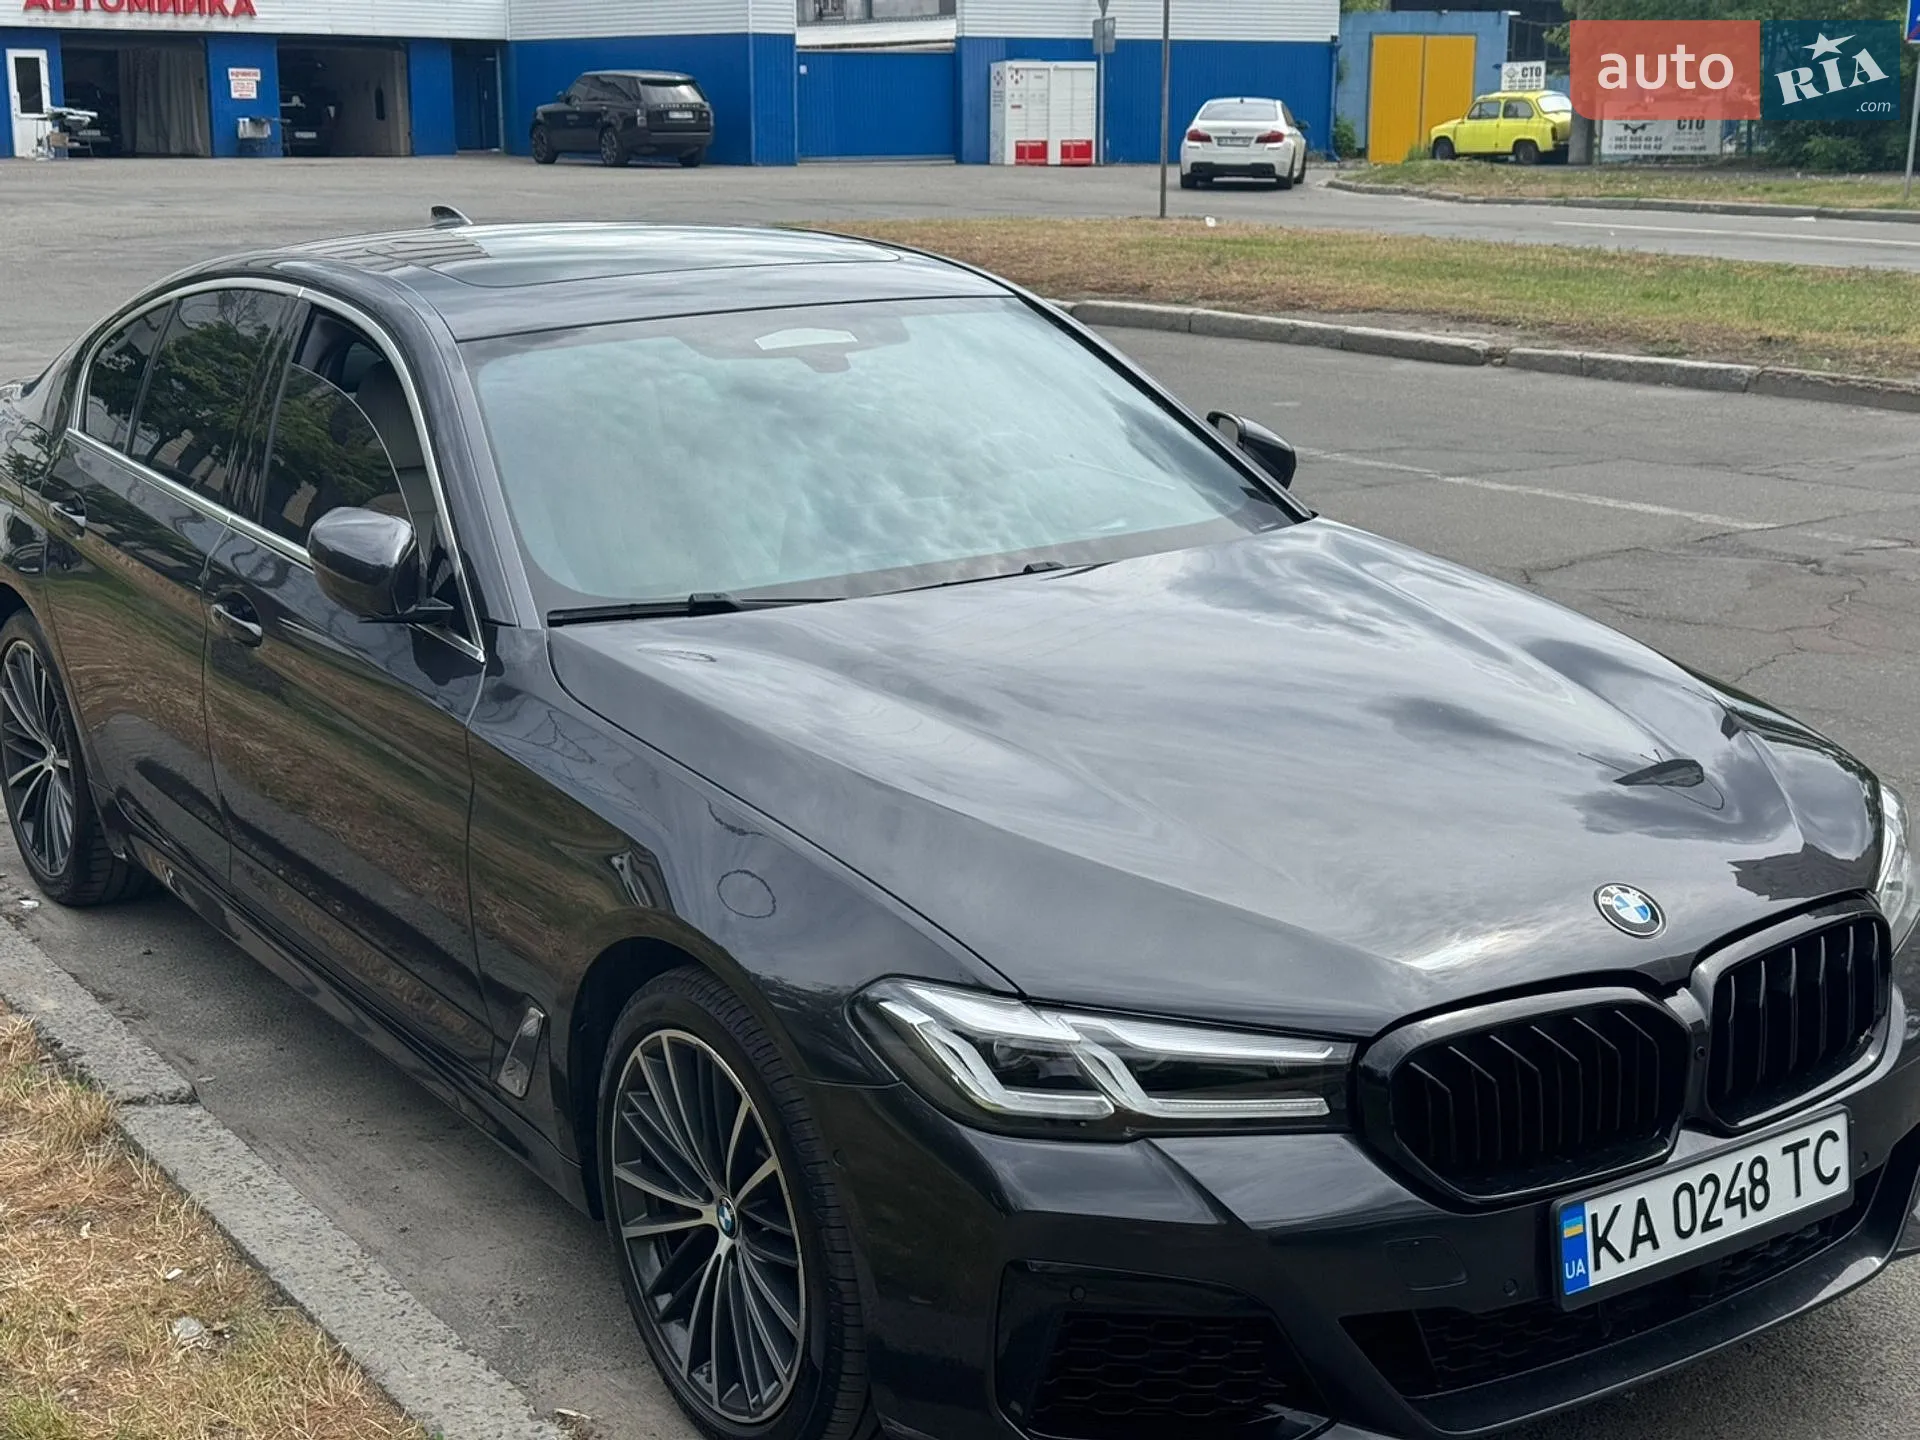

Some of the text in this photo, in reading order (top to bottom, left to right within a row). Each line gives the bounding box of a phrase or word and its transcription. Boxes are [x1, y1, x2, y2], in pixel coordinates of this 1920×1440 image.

[1590, 1129, 1841, 1272] KA 0248 TC
[1565, 1261, 1586, 1280] UA
